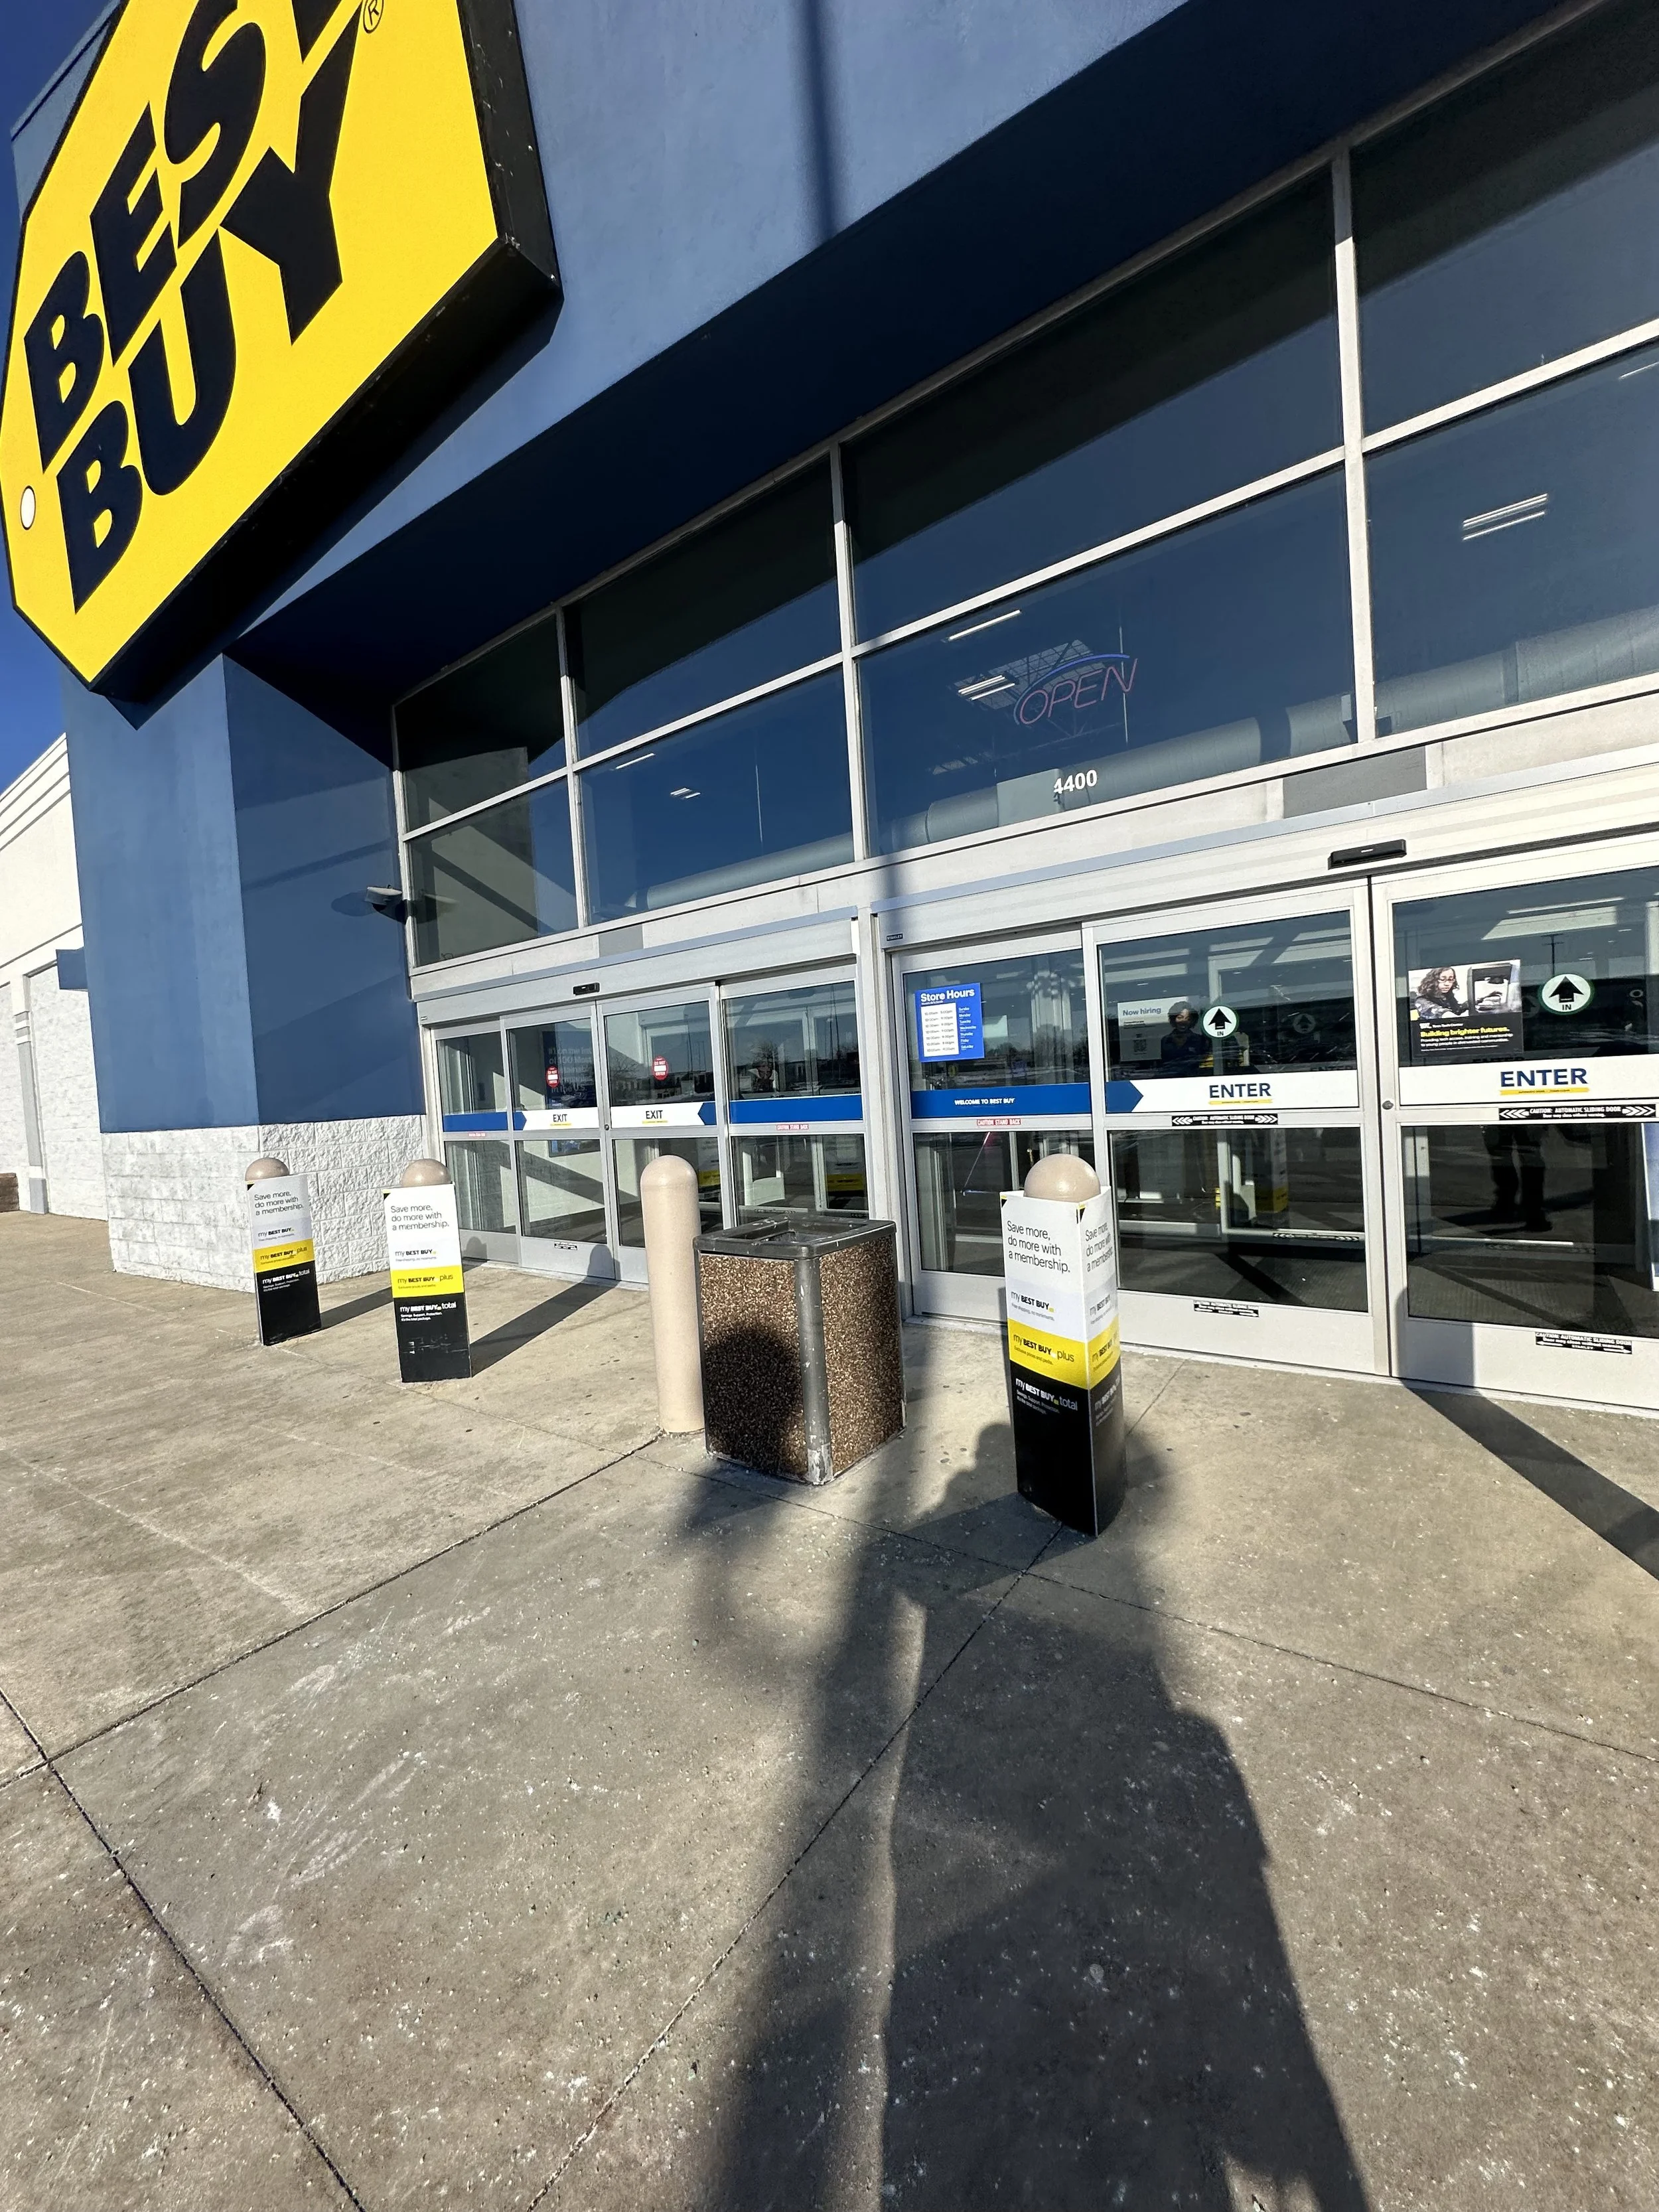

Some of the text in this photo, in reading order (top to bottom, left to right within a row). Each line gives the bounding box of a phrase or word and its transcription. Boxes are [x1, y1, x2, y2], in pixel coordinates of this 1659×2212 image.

[57, 0, 362, 614] BUY
[1019, 658, 1139, 725] OPEN
[1053, 770, 1098, 794] 4400
[920, 989, 975, 1002] Store Hours
[1500, 1068, 1588, 1087] ENTER
[1209, 1082, 1271, 1098] ENTER
[553, 1114, 567, 1122] EXIT
[646, 1110, 663, 1119] EXIT
[262, 1204, 304, 1215] membership.
[399, 1220, 449, 1230] membership.
[1007, 1220, 1050, 1240] Save more,
[1085, 1228, 1098, 1241] Save
[297, 1246, 307, 1254] plus
[1008, 1235, 1062, 1256] do more with
[1086, 1244, 1094, 1257] do
[1094, 1239, 1106, 1252] more
[1009, 1250, 1070, 1274] a membership.
[1087, 1262, 1091, 1272] a
[1011, 1291, 1049, 1310] my BEST BUY
[1013, 1334, 1074, 1363] my BEST BUY plus
[1015, 1378, 1025, 1390] my
[1025, 1383, 1040, 1396] BEST
[1041, 1390, 1055, 1402] BUY
[1059, 1396, 1078, 1411] total
